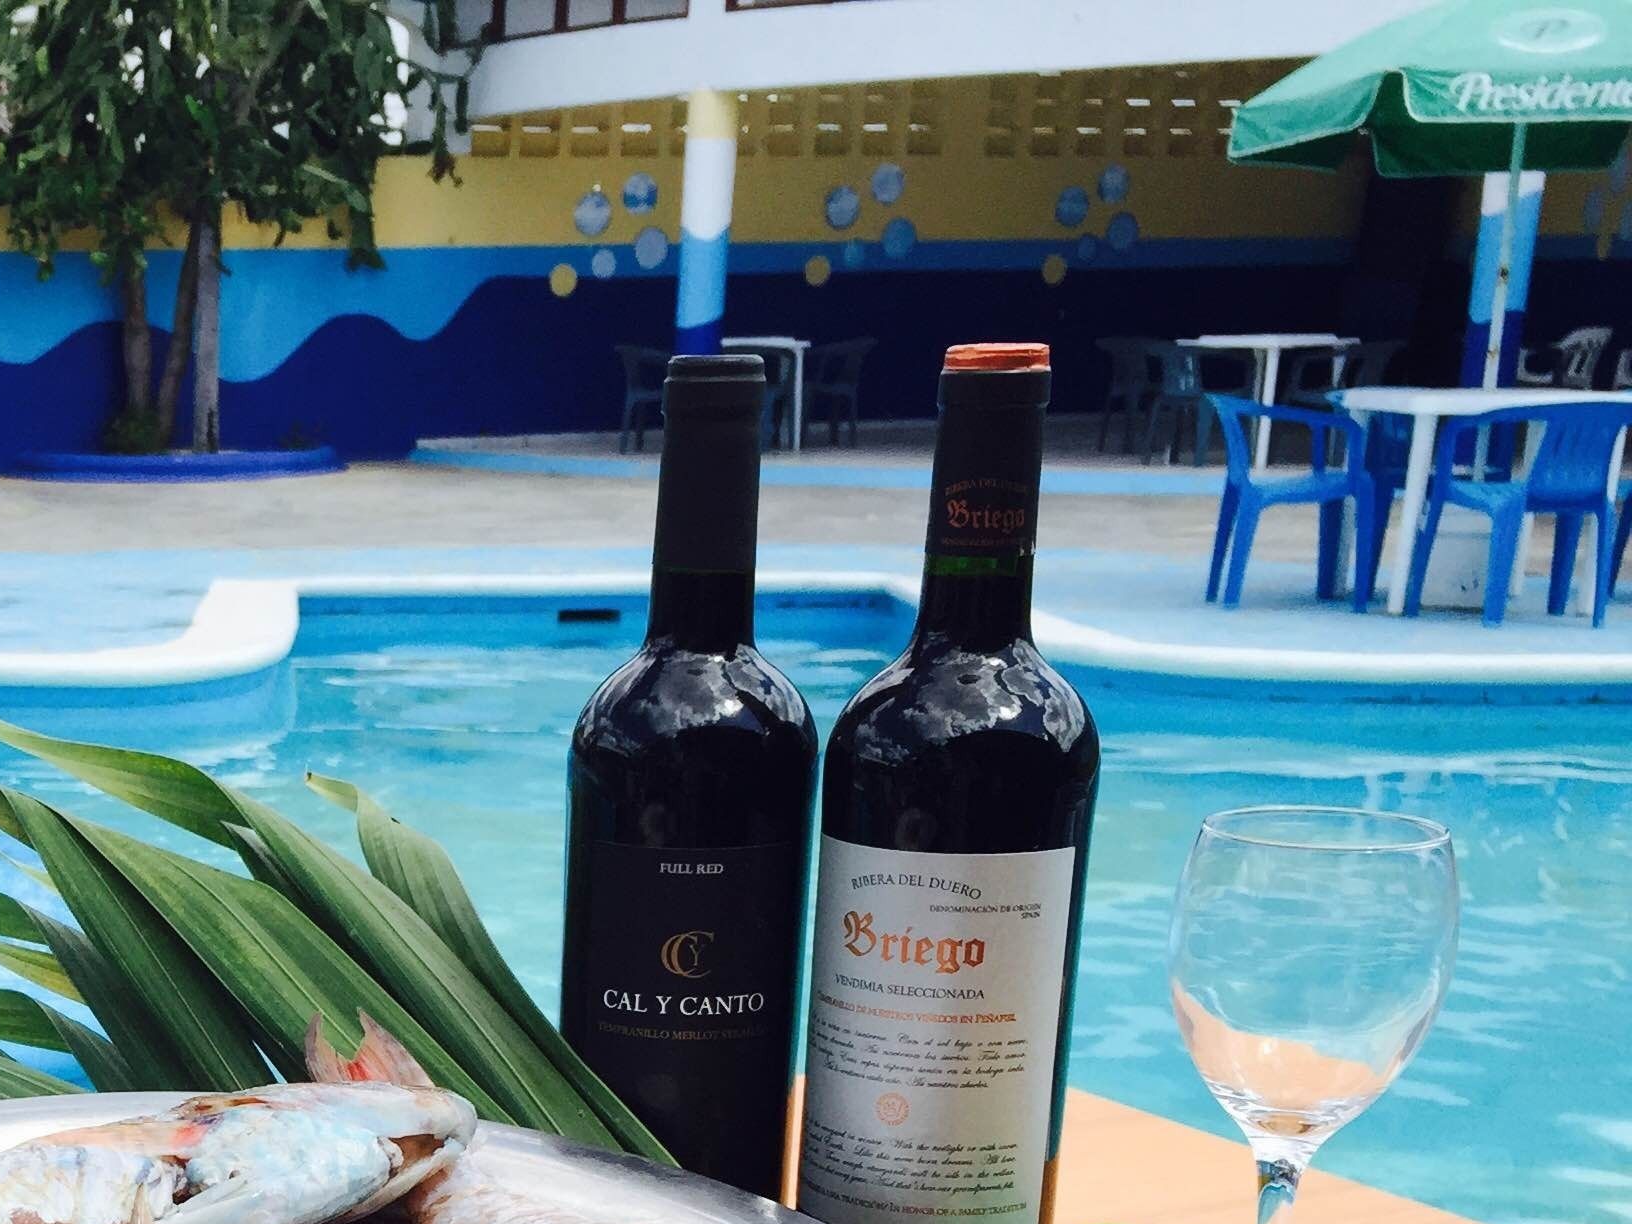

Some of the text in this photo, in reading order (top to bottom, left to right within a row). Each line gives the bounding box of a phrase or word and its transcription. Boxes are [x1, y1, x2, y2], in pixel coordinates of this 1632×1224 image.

[946, 499, 1025, 535] Briego
[659, 863, 724, 875] FULL RED
[851, 873, 982, 900] RIBERA DEL DUERO
[841, 909, 987, 976] Briego
[834, 974, 986, 1001] VENDIMIA SELECCIONADA
[603, 989, 765, 1016] CAL Y CANTO
[671, 1029, 718, 1041] MERLOT
